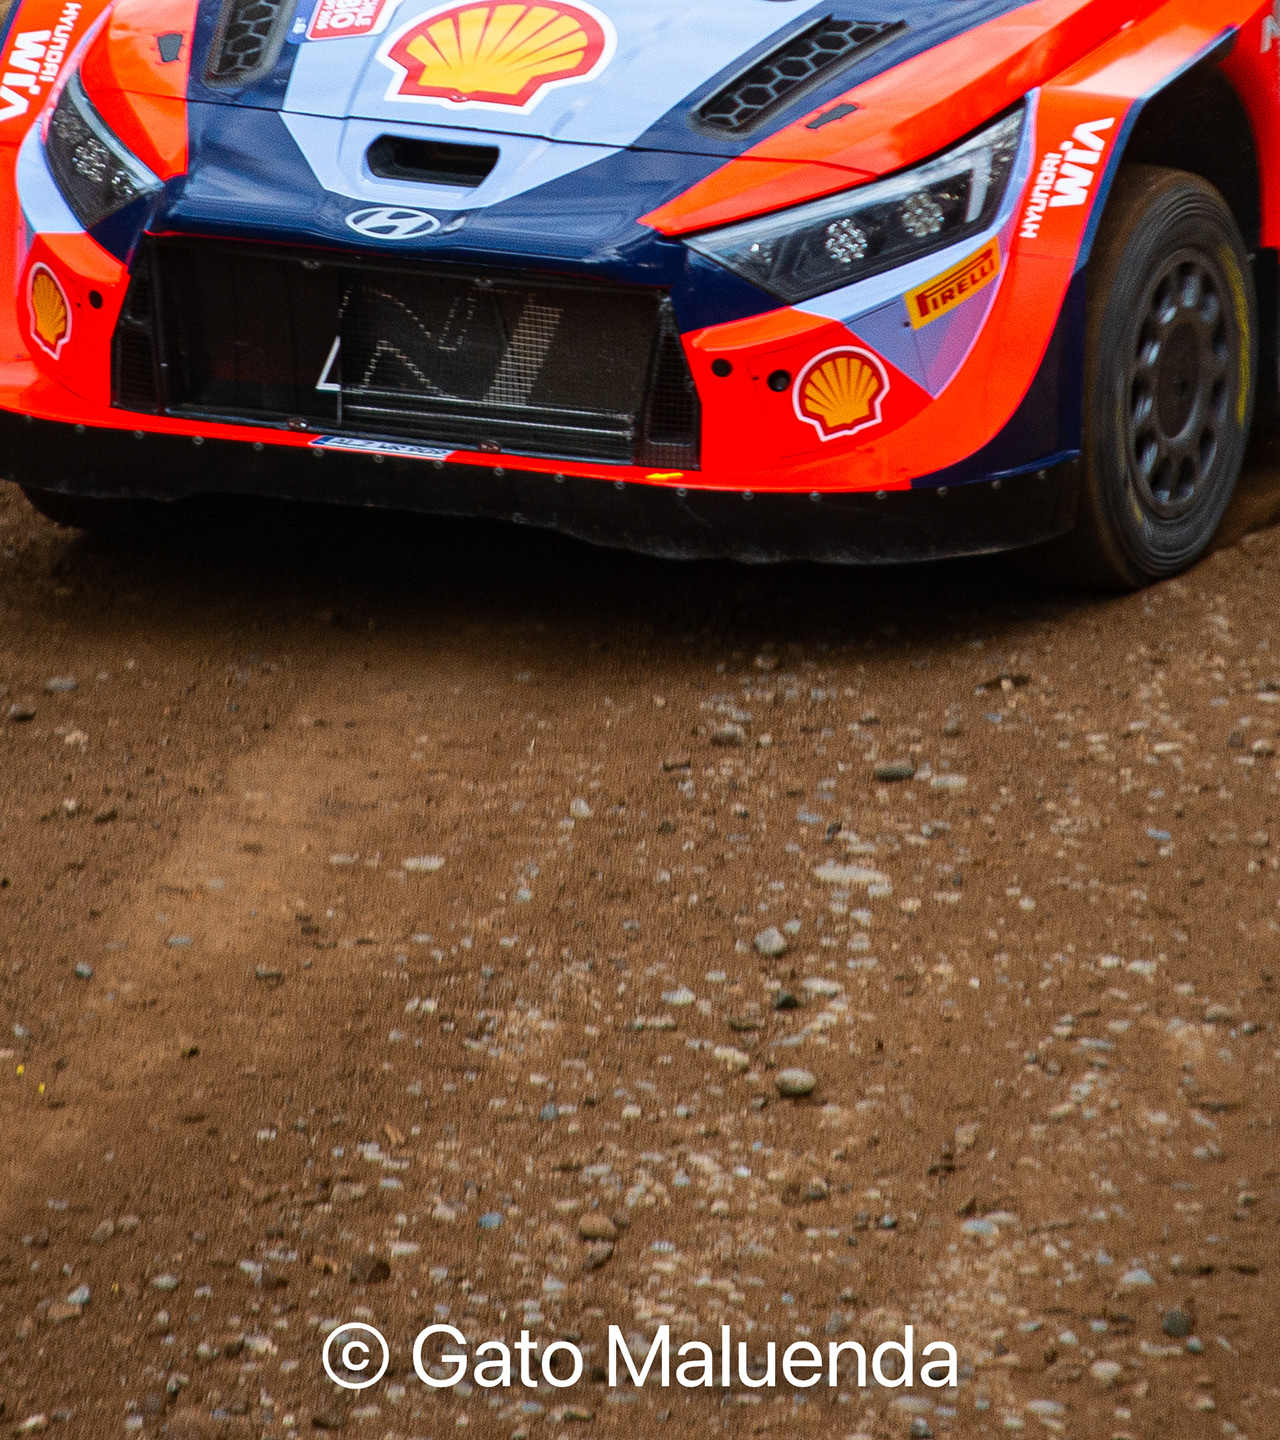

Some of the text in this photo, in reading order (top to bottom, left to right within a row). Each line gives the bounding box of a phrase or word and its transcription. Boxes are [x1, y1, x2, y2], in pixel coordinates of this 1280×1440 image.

[39, 2, 82, 82] HYUNDAI
[1020, 152, 1062, 239] HYUNDAI
[915, 248, 994, 318] PIRELLI
